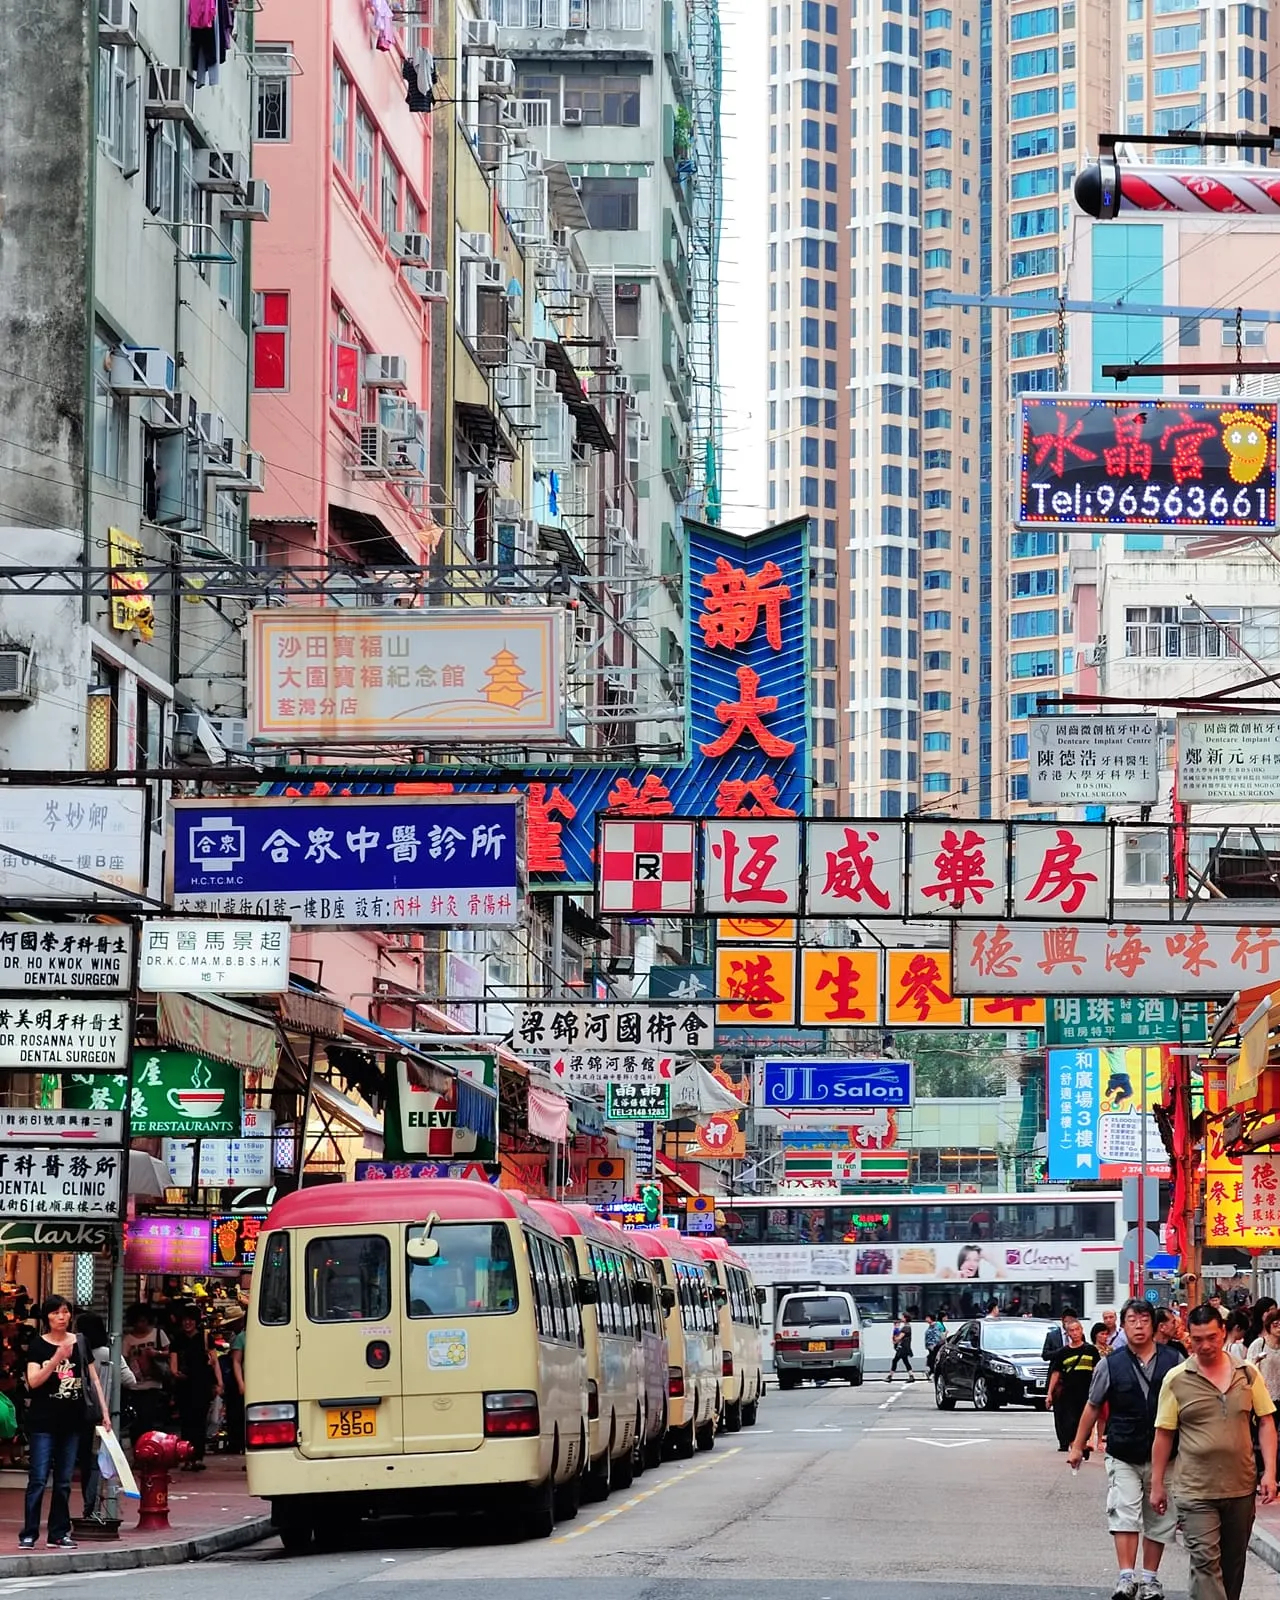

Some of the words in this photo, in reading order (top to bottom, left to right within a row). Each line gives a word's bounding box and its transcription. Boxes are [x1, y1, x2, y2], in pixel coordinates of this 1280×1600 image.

[1032, 411, 1218, 483] 水晶宮
[1031, 482, 1266, 518] Tel:96563661
[277, 635, 410, 659] 沙田寶福山
[277, 665, 466, 689] 大圍寶福紀念館
[277, 697, 358, 717] 荃灣分店
[1094, 738, 1123, 746] Implant
[1242, 736, 1271, 744] Implant
[1038, 769, 1150, 781] 香港大學牙科學士
[43, 800, 108, 832] 岑妙卿
[191, 876, 244, 886] H.C.T.C.M.C
[468, 894, 512, 916] 骨傷科
[150, 931, 281, 951] 西醫馬景超
[970, 923, 1280, 978] 德興海味行
[28, 957, 42, 969] HO
[49, 957, 82, 969] KWOK
[91, 958, 120, 970] WING
[24, 972, 67, 985] DENTAL
[71, 973, 119, 986] SURGEON
[519, 1010, 708, 1046] 梁錦河國術會
[21, 1034, 73, 1046] ROSANNA
[20, 1050, 62, 1062] DENTAL
[66, 1051, 116, 1063] SURGEON
[569, 1056, 656, 1072] 梁錦河醫館
[833, 1082, 904, 1098] Salon
[0, 1115, 113, 1127] 龍街61號順興樓二樓
[149, 1121, 234, 1132] RESTAURANTS
[62, 1181, 105, 1196] CLINIC
[340, 1411, 362, 1423] KP
[329, 1420, 374, 1437] 7950
